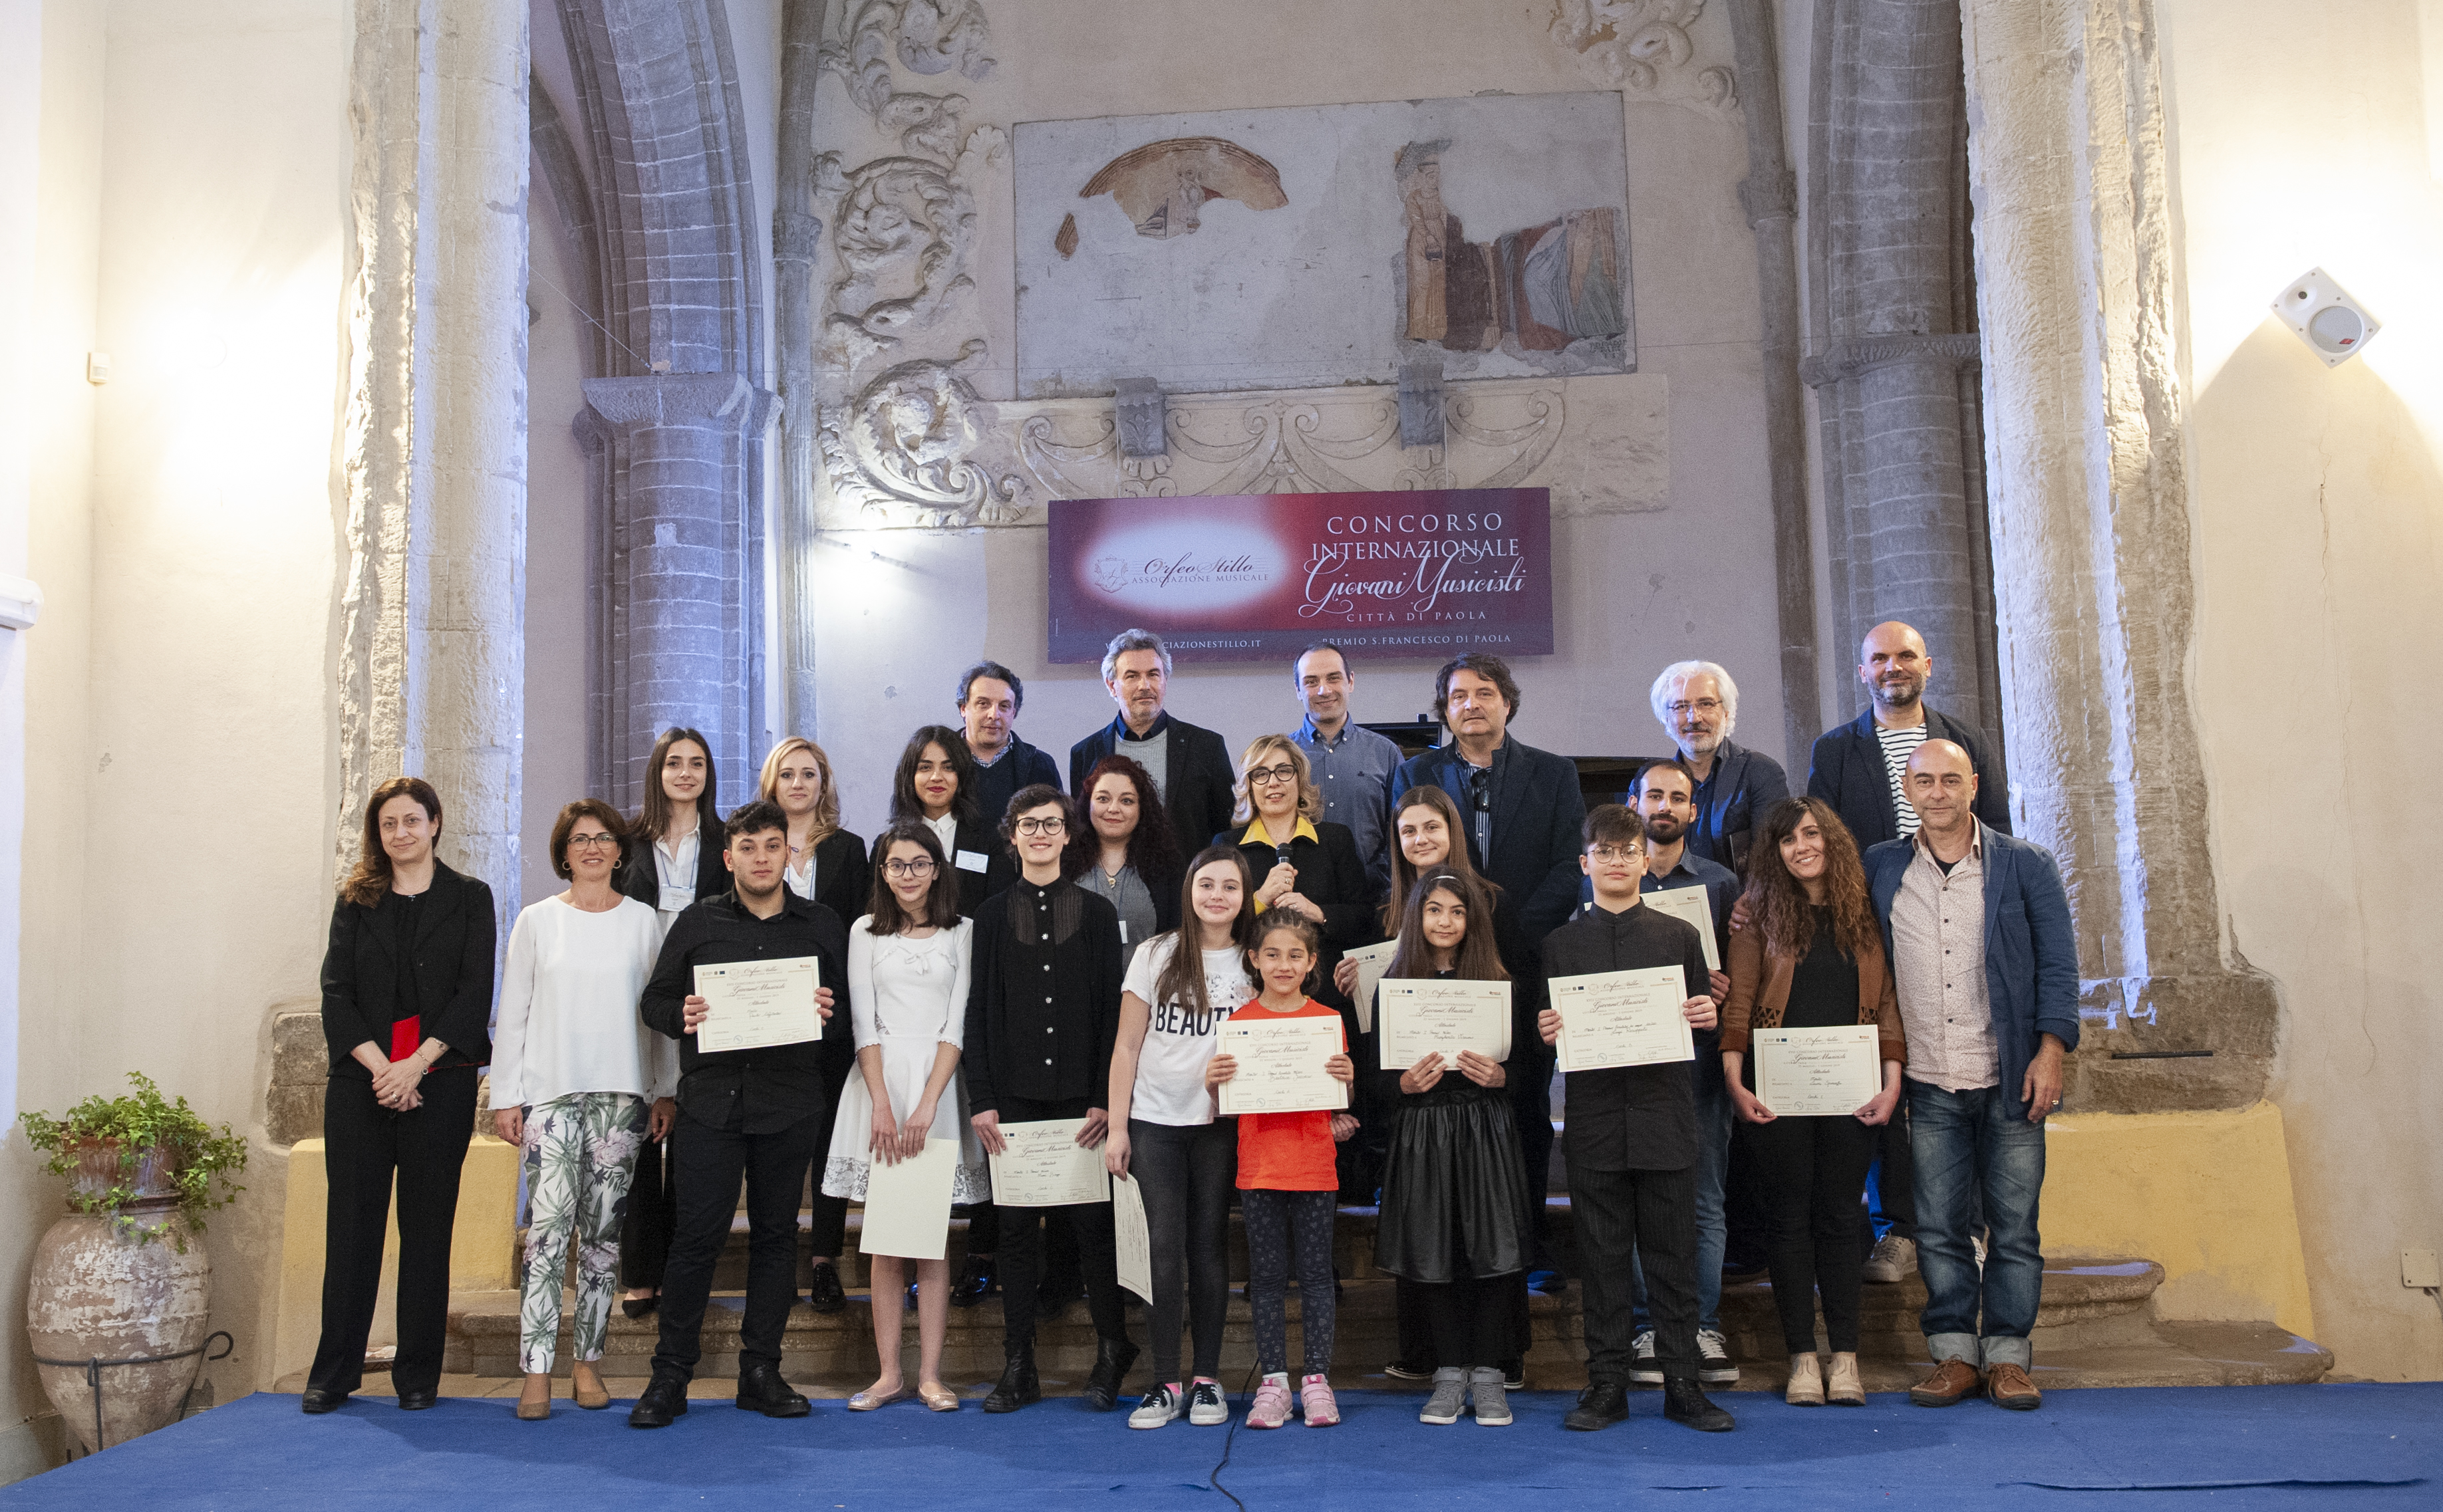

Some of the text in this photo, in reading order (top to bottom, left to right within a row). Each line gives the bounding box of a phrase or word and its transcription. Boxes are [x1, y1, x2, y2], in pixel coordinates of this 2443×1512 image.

[1327, 513, 1502, 535] CONCORSO
[1312, 539, 1519, 560] INTERNAZIONALE
[1132, 574, 1211, 584] ASSOCIAZIONE
[1144, 552, 1253, 587] Orfeo Stillo
[1298, 548, 1526, 617] Giovani Musicisti
[1347, 612, 1395, 622] CITTÀ
[1435, 611, 1486, 620] PAOLA
[1372, 636, 1450, 645] S.FRANCESCO
